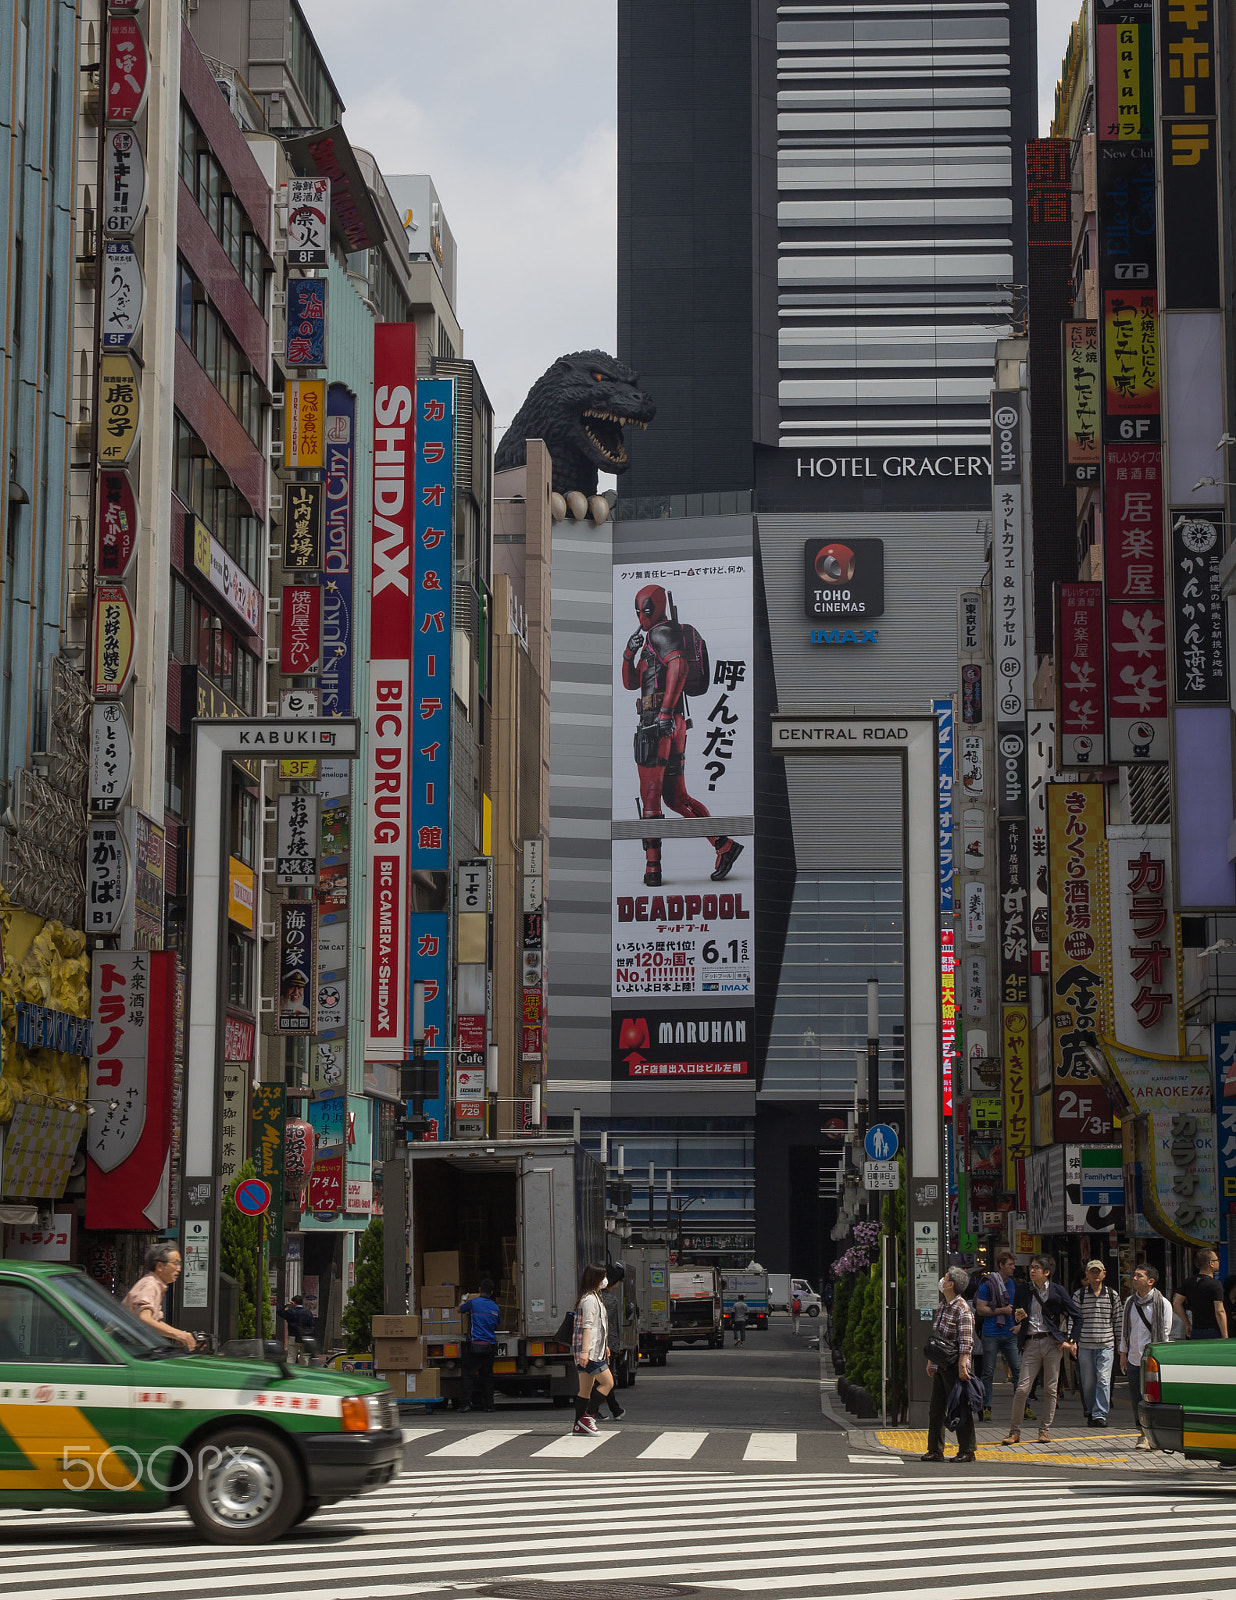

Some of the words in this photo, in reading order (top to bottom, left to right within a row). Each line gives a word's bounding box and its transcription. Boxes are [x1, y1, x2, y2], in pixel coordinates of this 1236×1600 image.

[1120, 15, 1136, 24] 7F
[111, 108, 132, 117] 7F
[1102, 149, 1128, 159] New
[107, 216, 132, 230] 6F
[299, 251, 315, 263] 8F
[1117, 265, 1146, 278] 7F
[287, 293, 324, 364] 海の家
[109, 333, 125, 344] 5F
[105, 384, 134, 437] 虎の子
[1119, 419, 1151, 439] 6F
[994, 406, 1019, 472] Booth
[103, 447, 121, 457] 4F
[797, 457, 877, 478] HOTEL
[882, 456, 992, 478] GRACERY
[1076, 466, 1097, 479] 6F
[1116, 467, 1157, 480] 居酒屋
[372, 384, 412, 598] SHIDAX
[290, 487, 314, 558] 山内農場
[1120, 492, 1156, 595] 居楽屋
[295, 557, 309, 566] 5F
[813, 590, 851, 601] TOHO
[813, 602, 866, 613] CINEMAS
[290, 591, 312, 667] 焼肉屋さかい
[965, 603, 978, 647] 東京ビル
[810, 629, 880, 645] IMAX
[1073, 610, 1089, 659] 居楽屋
[374, 680, 403, 738] BIC
[702, 660, 747, 792] 呼んだ?
[779, 728, 857, 740] CENTRAL
[863, 728, 908, 740] ROAD
[289, 761, 310, 774] 3F
[999, 733, 1024, 802] Booth
[372, 747, 403, 845] DRUG
[96, 799, 114, 810] 1F
[939, 773, 953, 904] カラオケランド
[1063, 790, 1091, 931] きんくら酒場
[92, 842, 116, 904] かっぱ
[379, 861, 393, 887] BIC
[616, 893, 750, 923] DEADPOOL
[93, 912, 112, 923] B1
[1001, 887, 1028, 963] 甘太郎
[656, 924, 710, 933] デッドプール
[1067, 931, 1087, 941] KIN
[285, 910, 306, 967] 海の家
[1073, 941, 1086, 949] no
[1127, 852, 1173, 1029] カラオケ
[702, 940, 739, 964] 6.1
[1067, 947, 1093, 958] KURA
[1005, 973, 1027, 986] 4F
[129, 957, 147, 1028] 大衆酒場
[721, 984, 749, 992] IMAX
[1005, 989, 1027, 1002] 3F
[96, 964, 127, 1087] トラノコ
[658, 1021, 747, 1044] MARUHAN
[457, 1052, 484, 1064] Cafe
[460, 1108, 480, 1116] 729
[1084, 1172, 1123, 1182] FamilyMart
[1171, 1113, 1202, 1226] カラオケ
[312, 1177, 340, 1188] アダム
[19, 1233, 68, 1245] トラノコ
